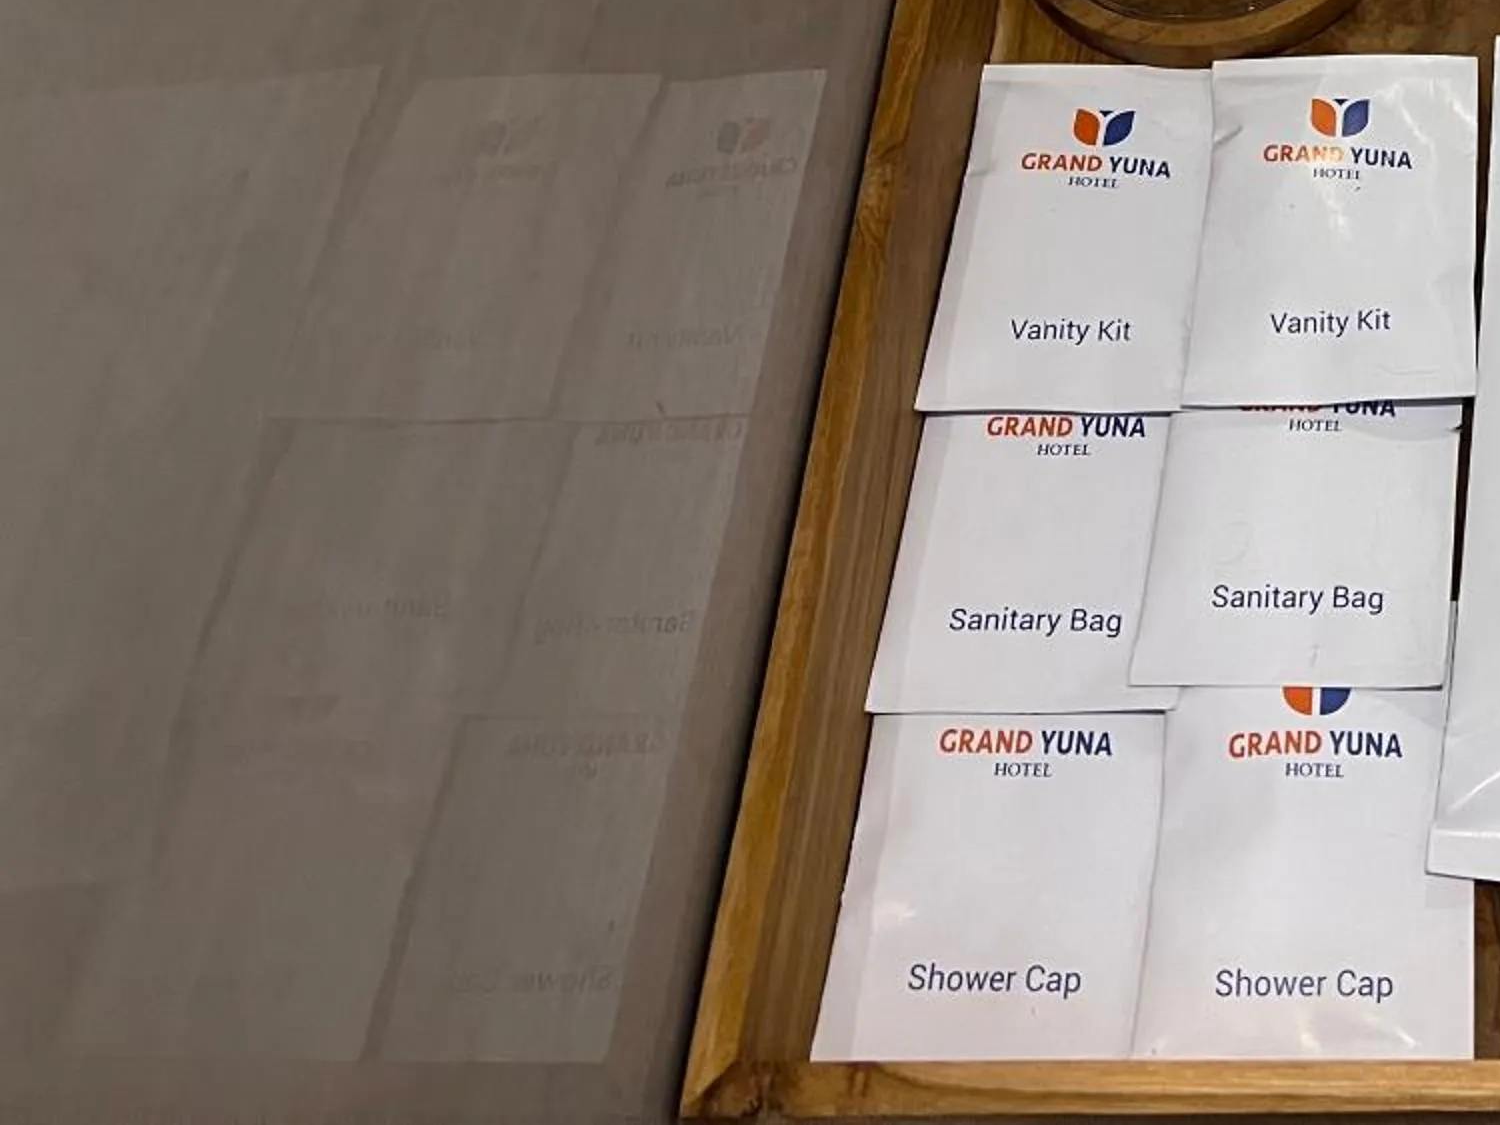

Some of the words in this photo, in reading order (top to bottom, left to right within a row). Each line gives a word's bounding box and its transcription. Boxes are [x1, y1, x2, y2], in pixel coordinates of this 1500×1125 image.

[1021, 153, 1102, 172] GRAND
[1109, 156, 1171, 178] YUNA
[1263, 144, 1344, 163] GRAND
[1351, 146, 1412, 169] YUNA
[1068, 176, 1119, 189] HOTEL
[1313, 168, 1360, 180] HOTEL
[1011, 318, 1091, 346] Vanity
[1098, 318, 1131, 342] Kit
[1270, 310, 1350, 338] Vanity
[1357, 308, 1391, 331] Kit
[987, 416, 1073, 437] GRAND
[1081, 415, 1146, 437] YUNA
[1289, 418, 1341, 432] HOTEL
[1037, 443, 1092, 456] HOTEL
[1212, 584, 1324, 615] Sanitary
[1332, 585, 1384, 615] Bag
[949, 606, 1063, 638] Sanitary
[1070, 608, 1122, 638] Bag
[940, 729, 1033, 754] GRAND
[1041, 730, 1113, 757] YUNA
[1228, 730, 1322, 758] GRAND
[1329, 730, 1403, 758] YUNA
[994, 762, 1052, 777] HOTEL
[1285, 763, 1344, 778] HOTEL
[908, 962, 1017, 992] Shower
[1025, 964, 1081, 1000] Cap
[1215, 968, 1327, 997] Shower
[1337, 969, 1393, 1004] Cap
